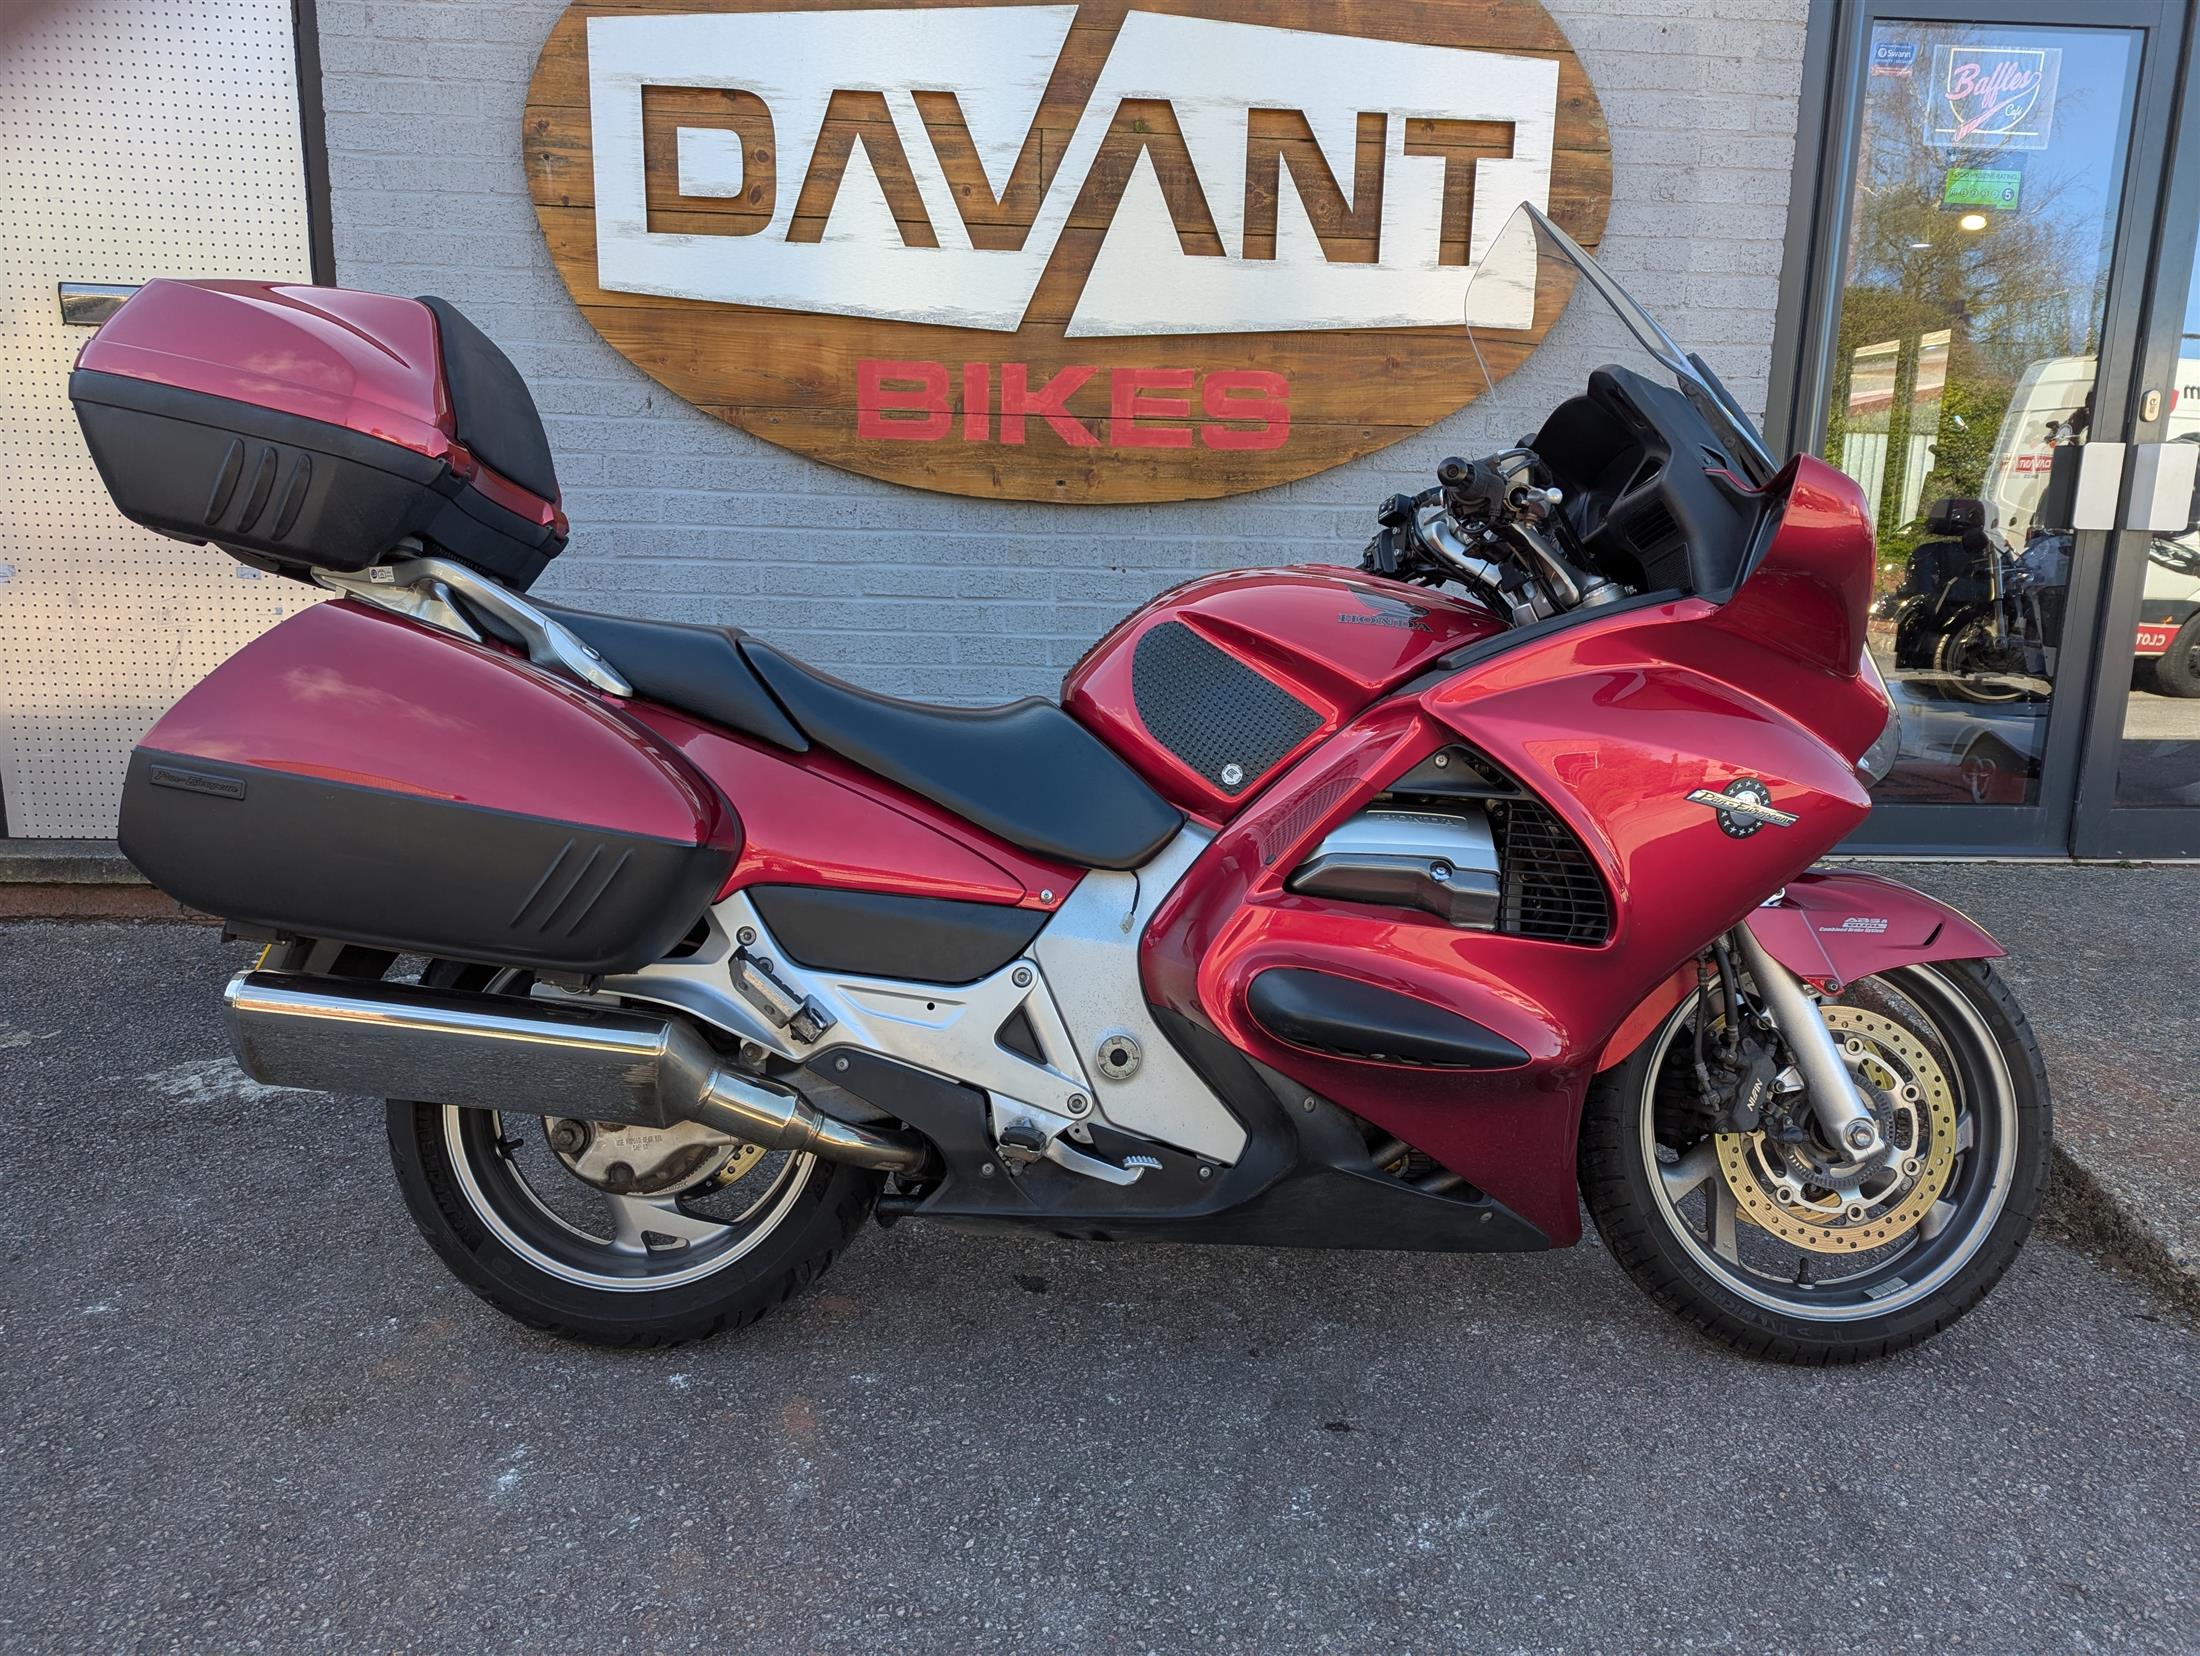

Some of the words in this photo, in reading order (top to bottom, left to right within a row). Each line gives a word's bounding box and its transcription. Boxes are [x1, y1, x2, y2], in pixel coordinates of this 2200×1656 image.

[1887, 49, 1911, 58] Swann
[1945, 61, 2041, 109] Baffles
[641, 83, 1515, 268] DAVANT
[857, 360, 1291, 452] BIKES
[1338, 614, 1434, 633] HONDA
[1746, 1077, 1763, 1112] NISSIN
